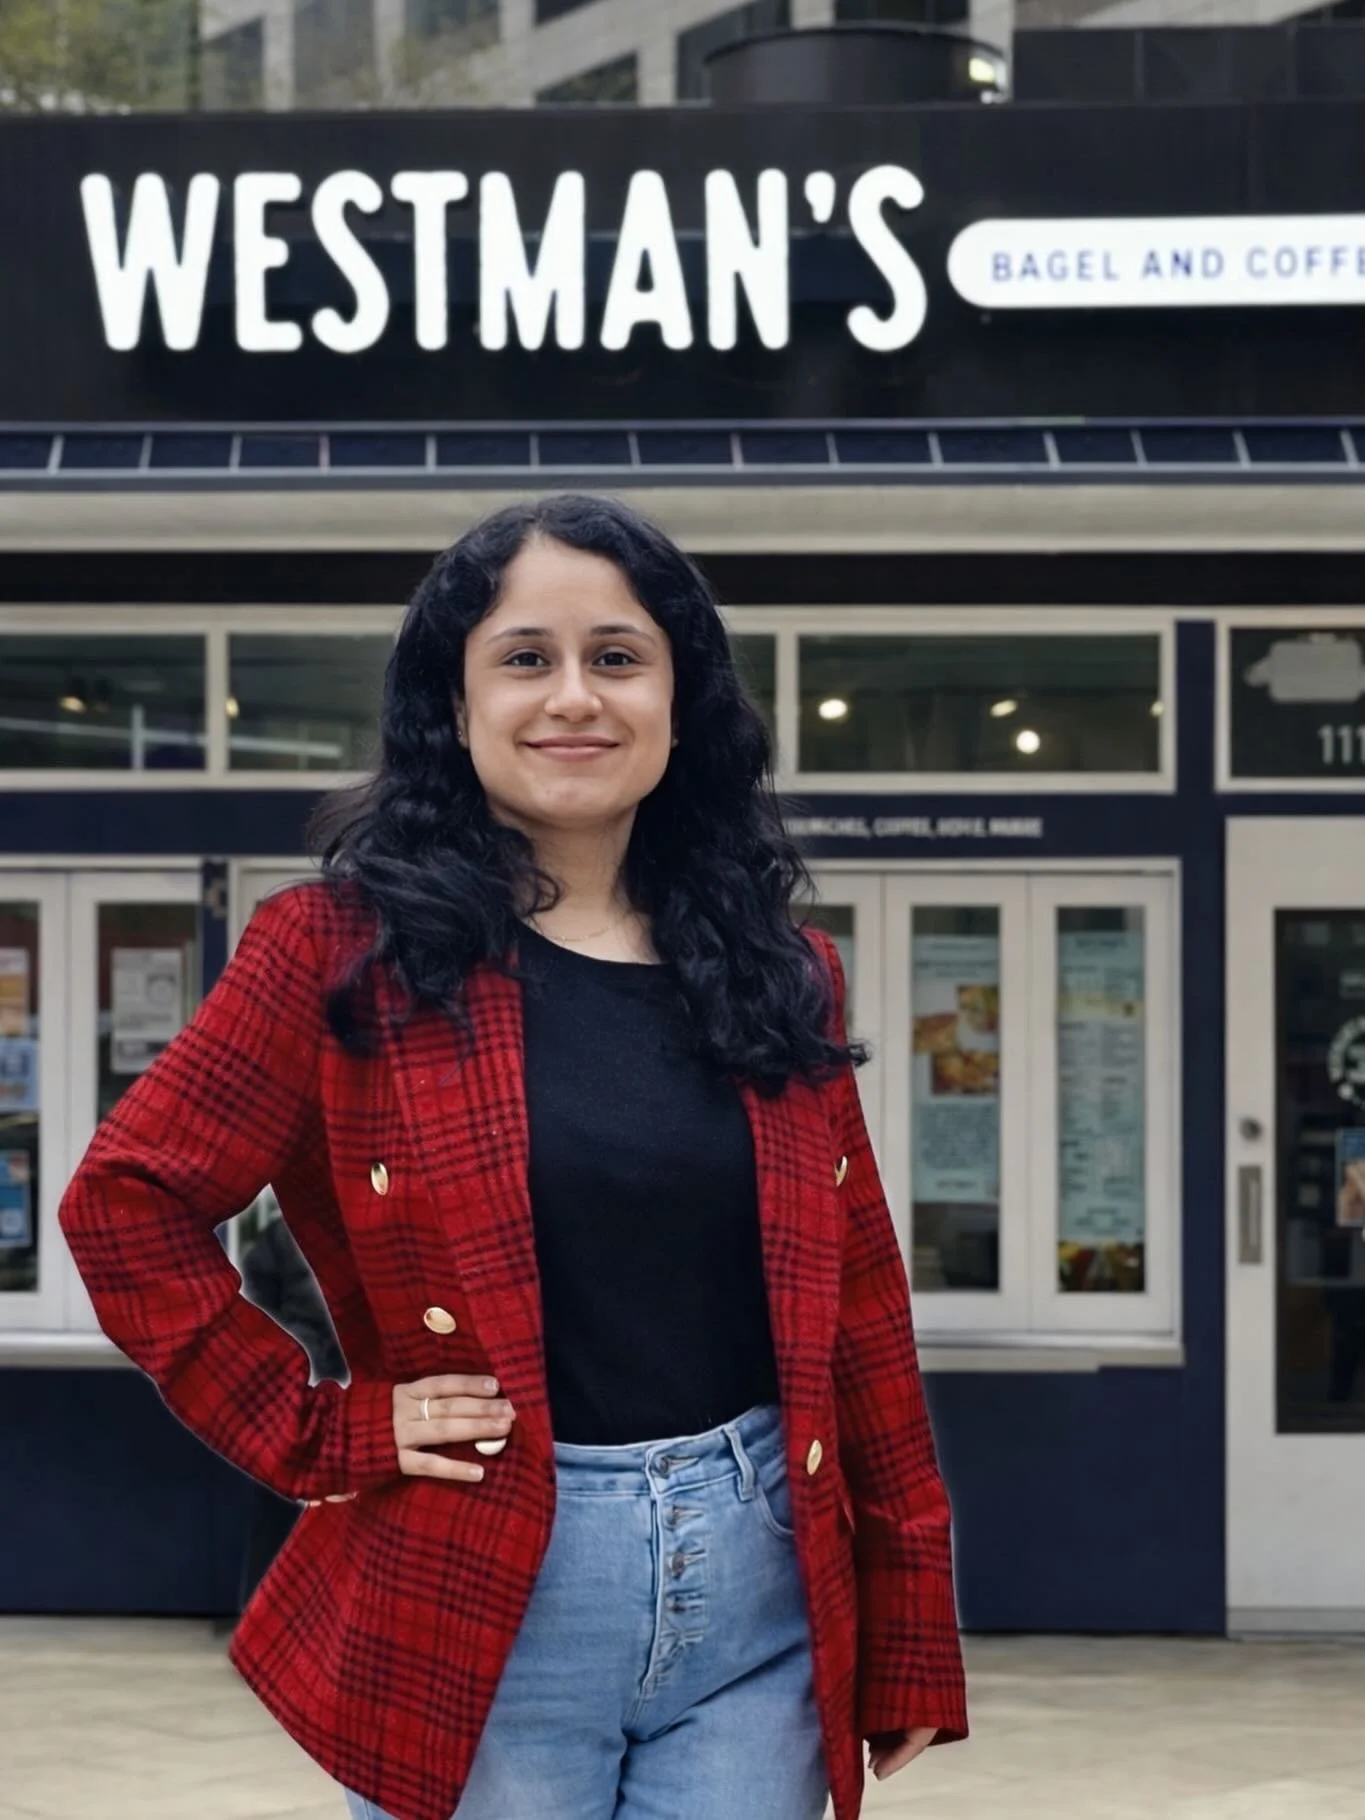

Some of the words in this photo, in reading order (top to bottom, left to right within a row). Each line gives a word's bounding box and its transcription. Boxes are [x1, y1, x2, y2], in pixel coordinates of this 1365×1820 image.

[80, 164, 927, 353] WESTMAN'S
[991, 250, 1118, 282] BAGEL
[1140, 247, 1225, 279] AND
